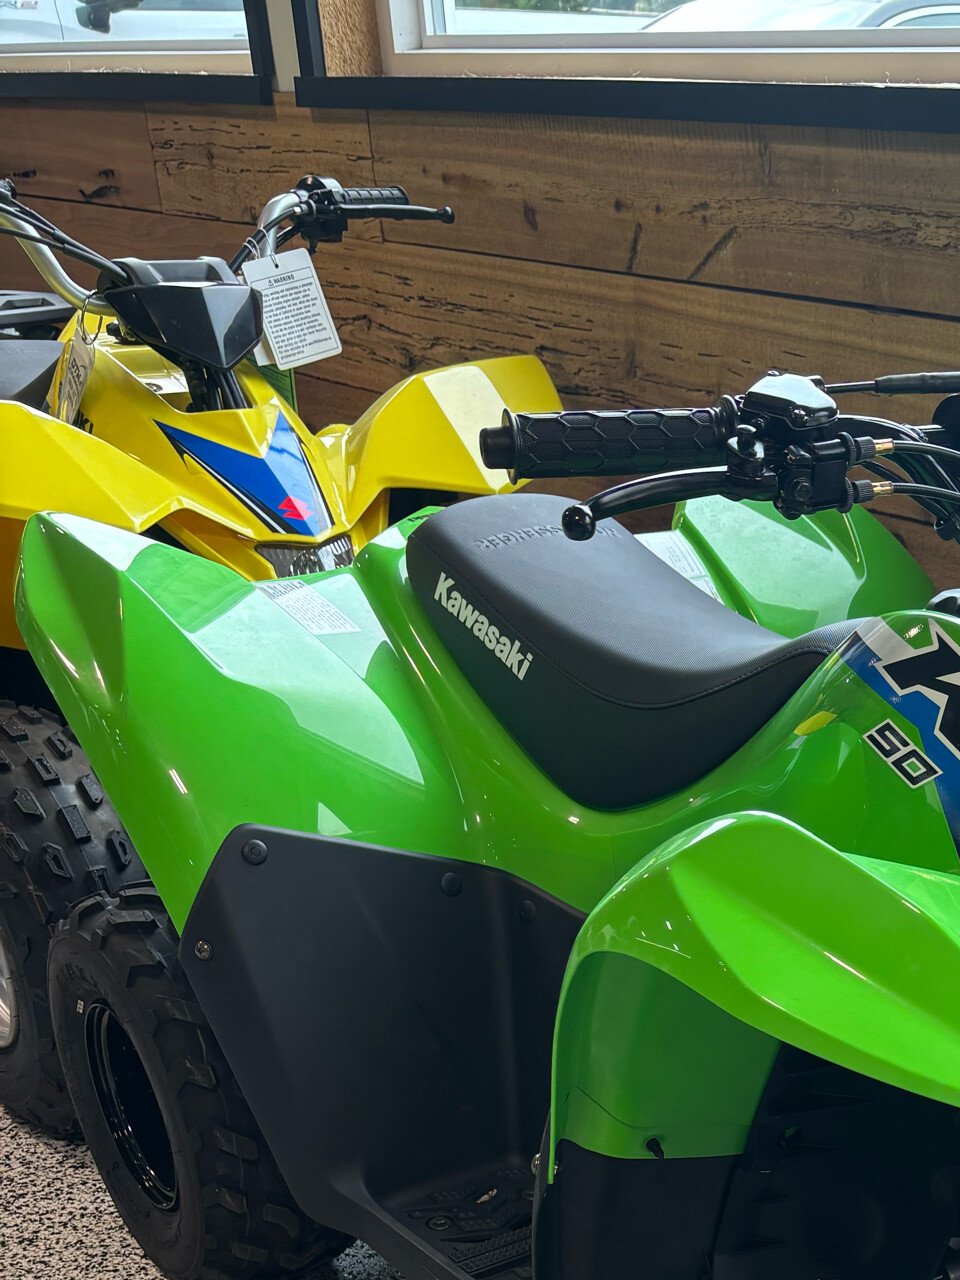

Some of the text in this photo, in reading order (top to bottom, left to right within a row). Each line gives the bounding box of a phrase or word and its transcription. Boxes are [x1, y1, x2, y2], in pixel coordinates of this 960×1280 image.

[273, 274, 295, 285] WARNING
[433, 571, 534, 681] Kawasaki
[863, 719, 943, 789] 50
